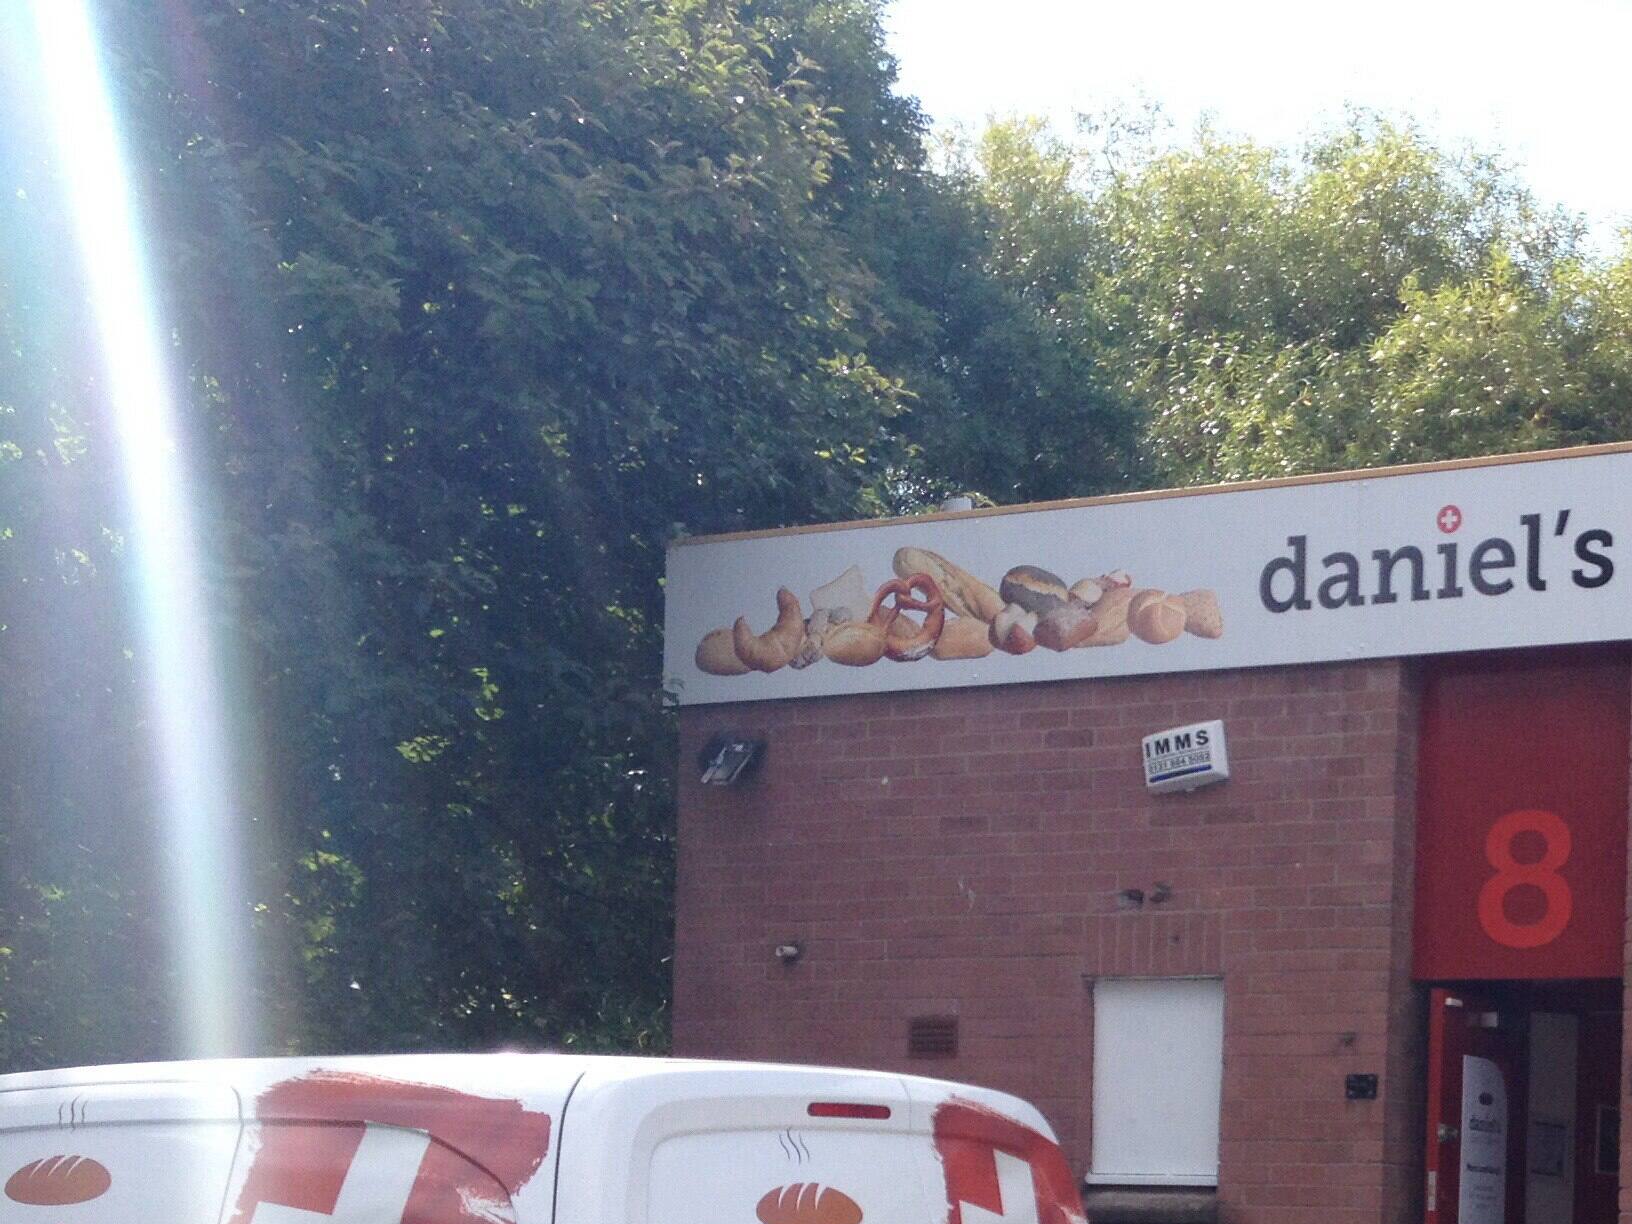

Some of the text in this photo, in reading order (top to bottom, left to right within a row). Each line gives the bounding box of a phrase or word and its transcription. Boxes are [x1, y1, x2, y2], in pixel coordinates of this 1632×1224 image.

[1260, 504, 1617, 614] daniel's
[1145, 730, 1209, 758] IMMS
[1477, 809, 1573, 948] 8
